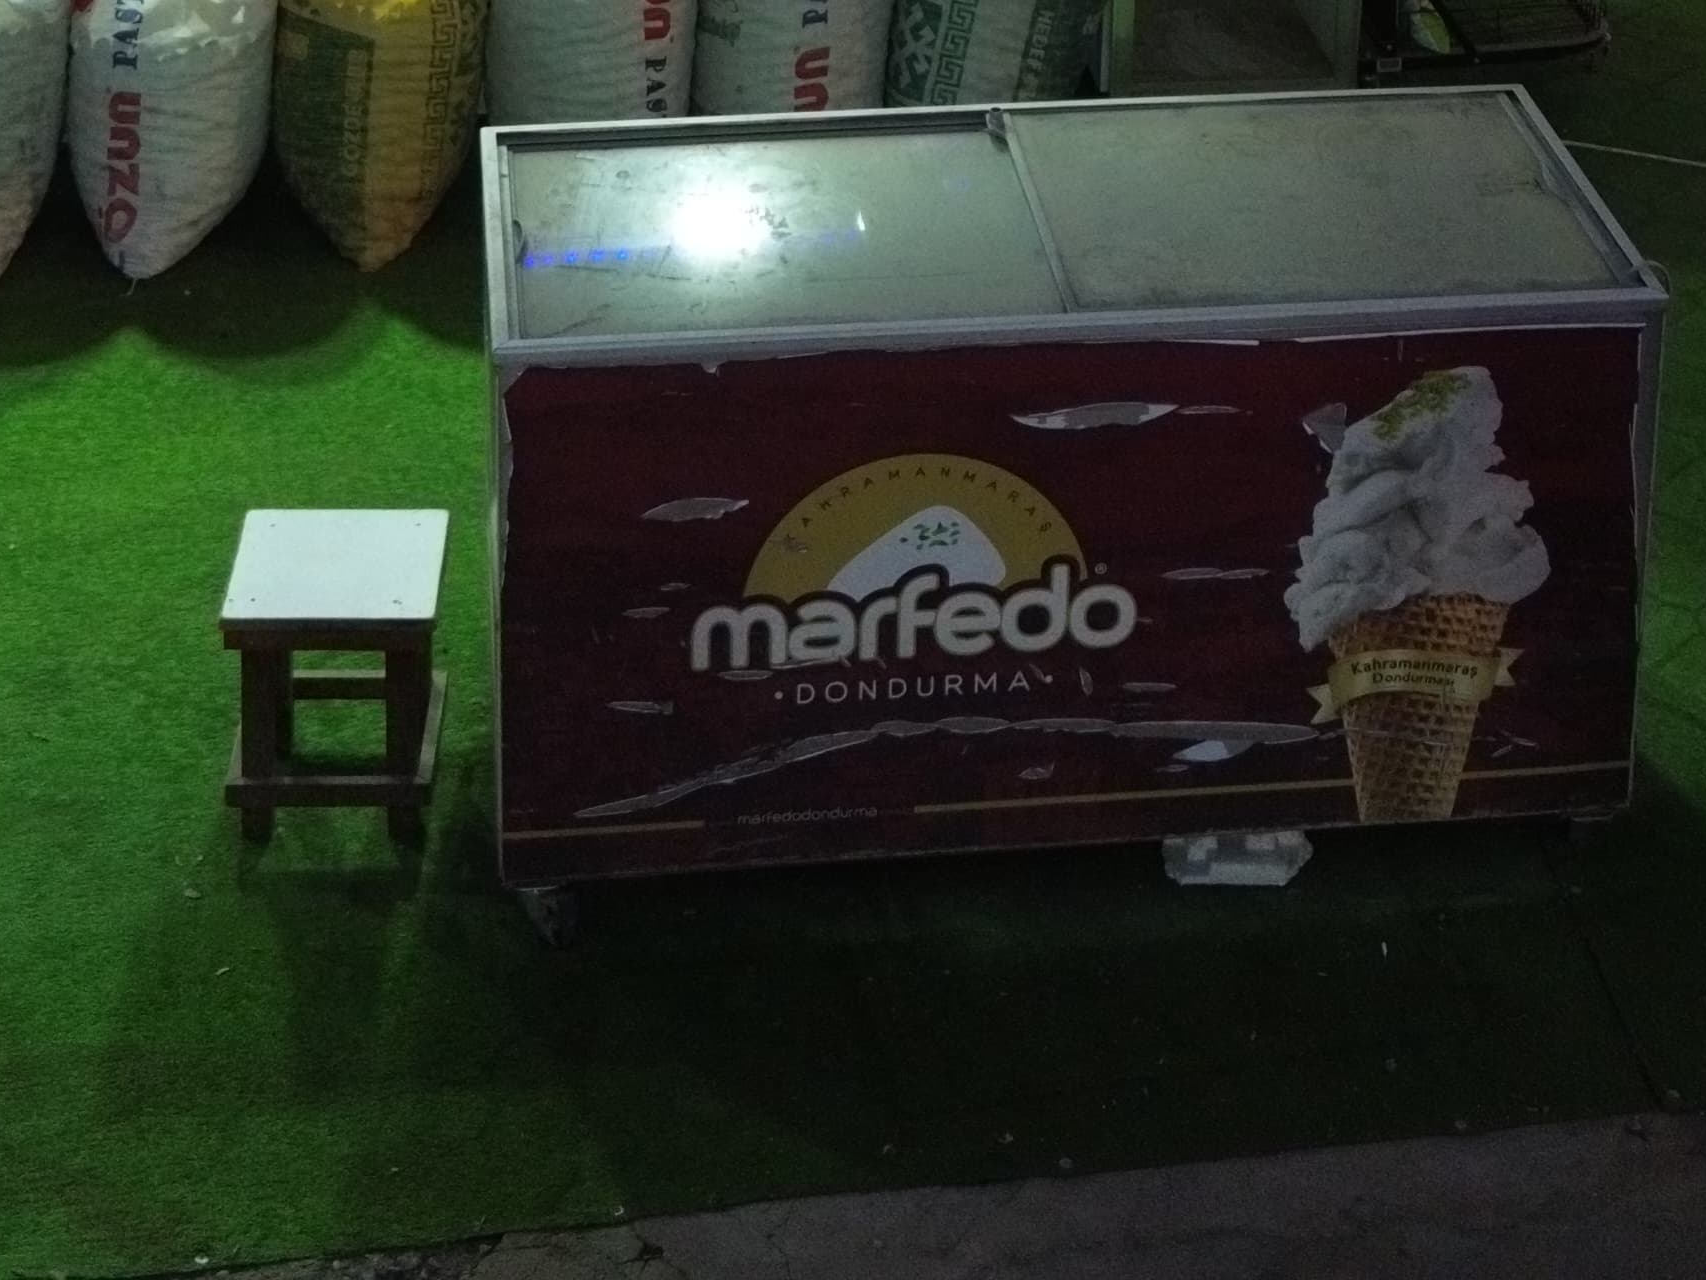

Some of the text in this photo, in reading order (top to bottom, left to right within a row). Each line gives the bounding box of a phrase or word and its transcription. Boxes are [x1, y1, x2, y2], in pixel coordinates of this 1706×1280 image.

[693, 564, 1137, 672] marfedo
[1350, 657, 1479, 679] Kahramanmaraş
[795, 670, 1031, 705] DONDURMA
